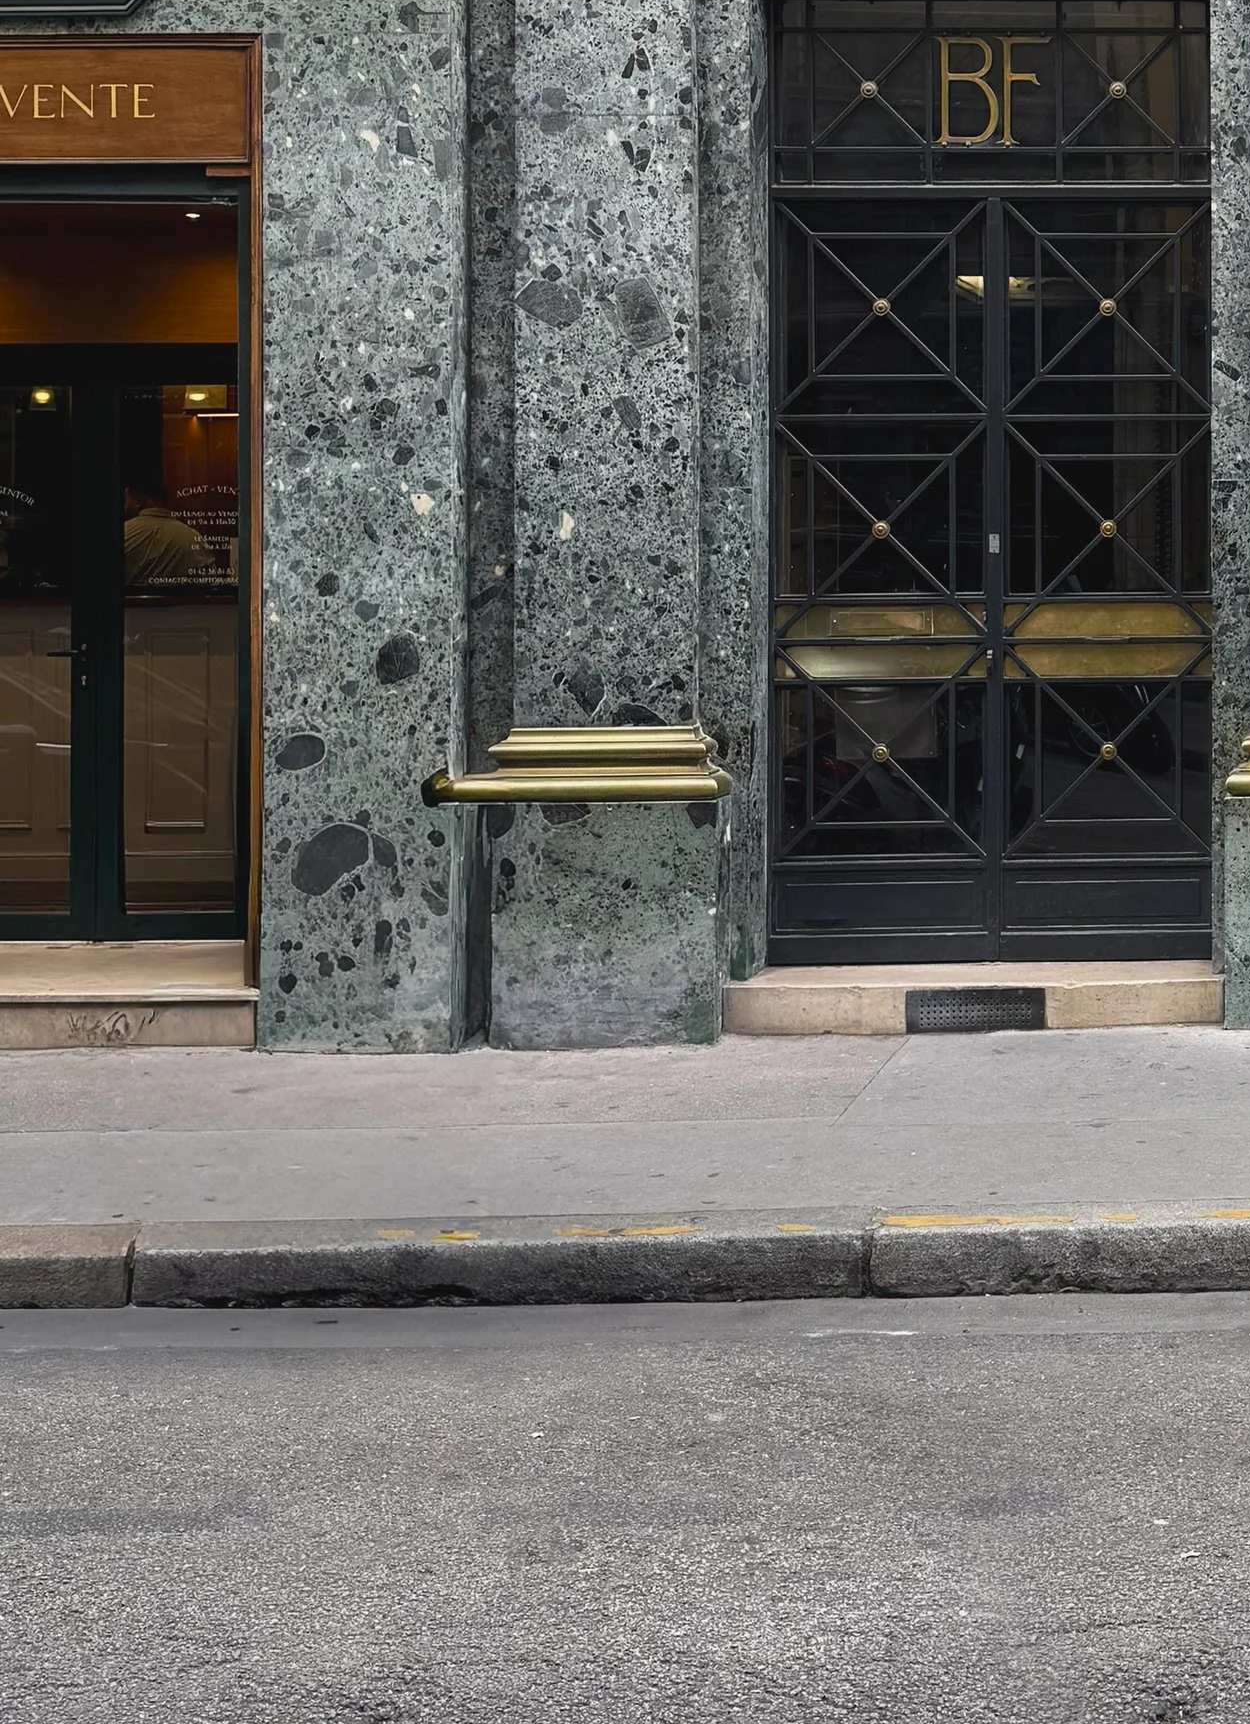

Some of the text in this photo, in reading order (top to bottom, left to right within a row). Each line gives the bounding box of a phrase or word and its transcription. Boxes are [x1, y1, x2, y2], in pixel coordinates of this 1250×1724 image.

[0, 84, 155, 119] VENTE
[932, 36, 1052, 145] BF
[176, 484, 209, 498] ACHAT
